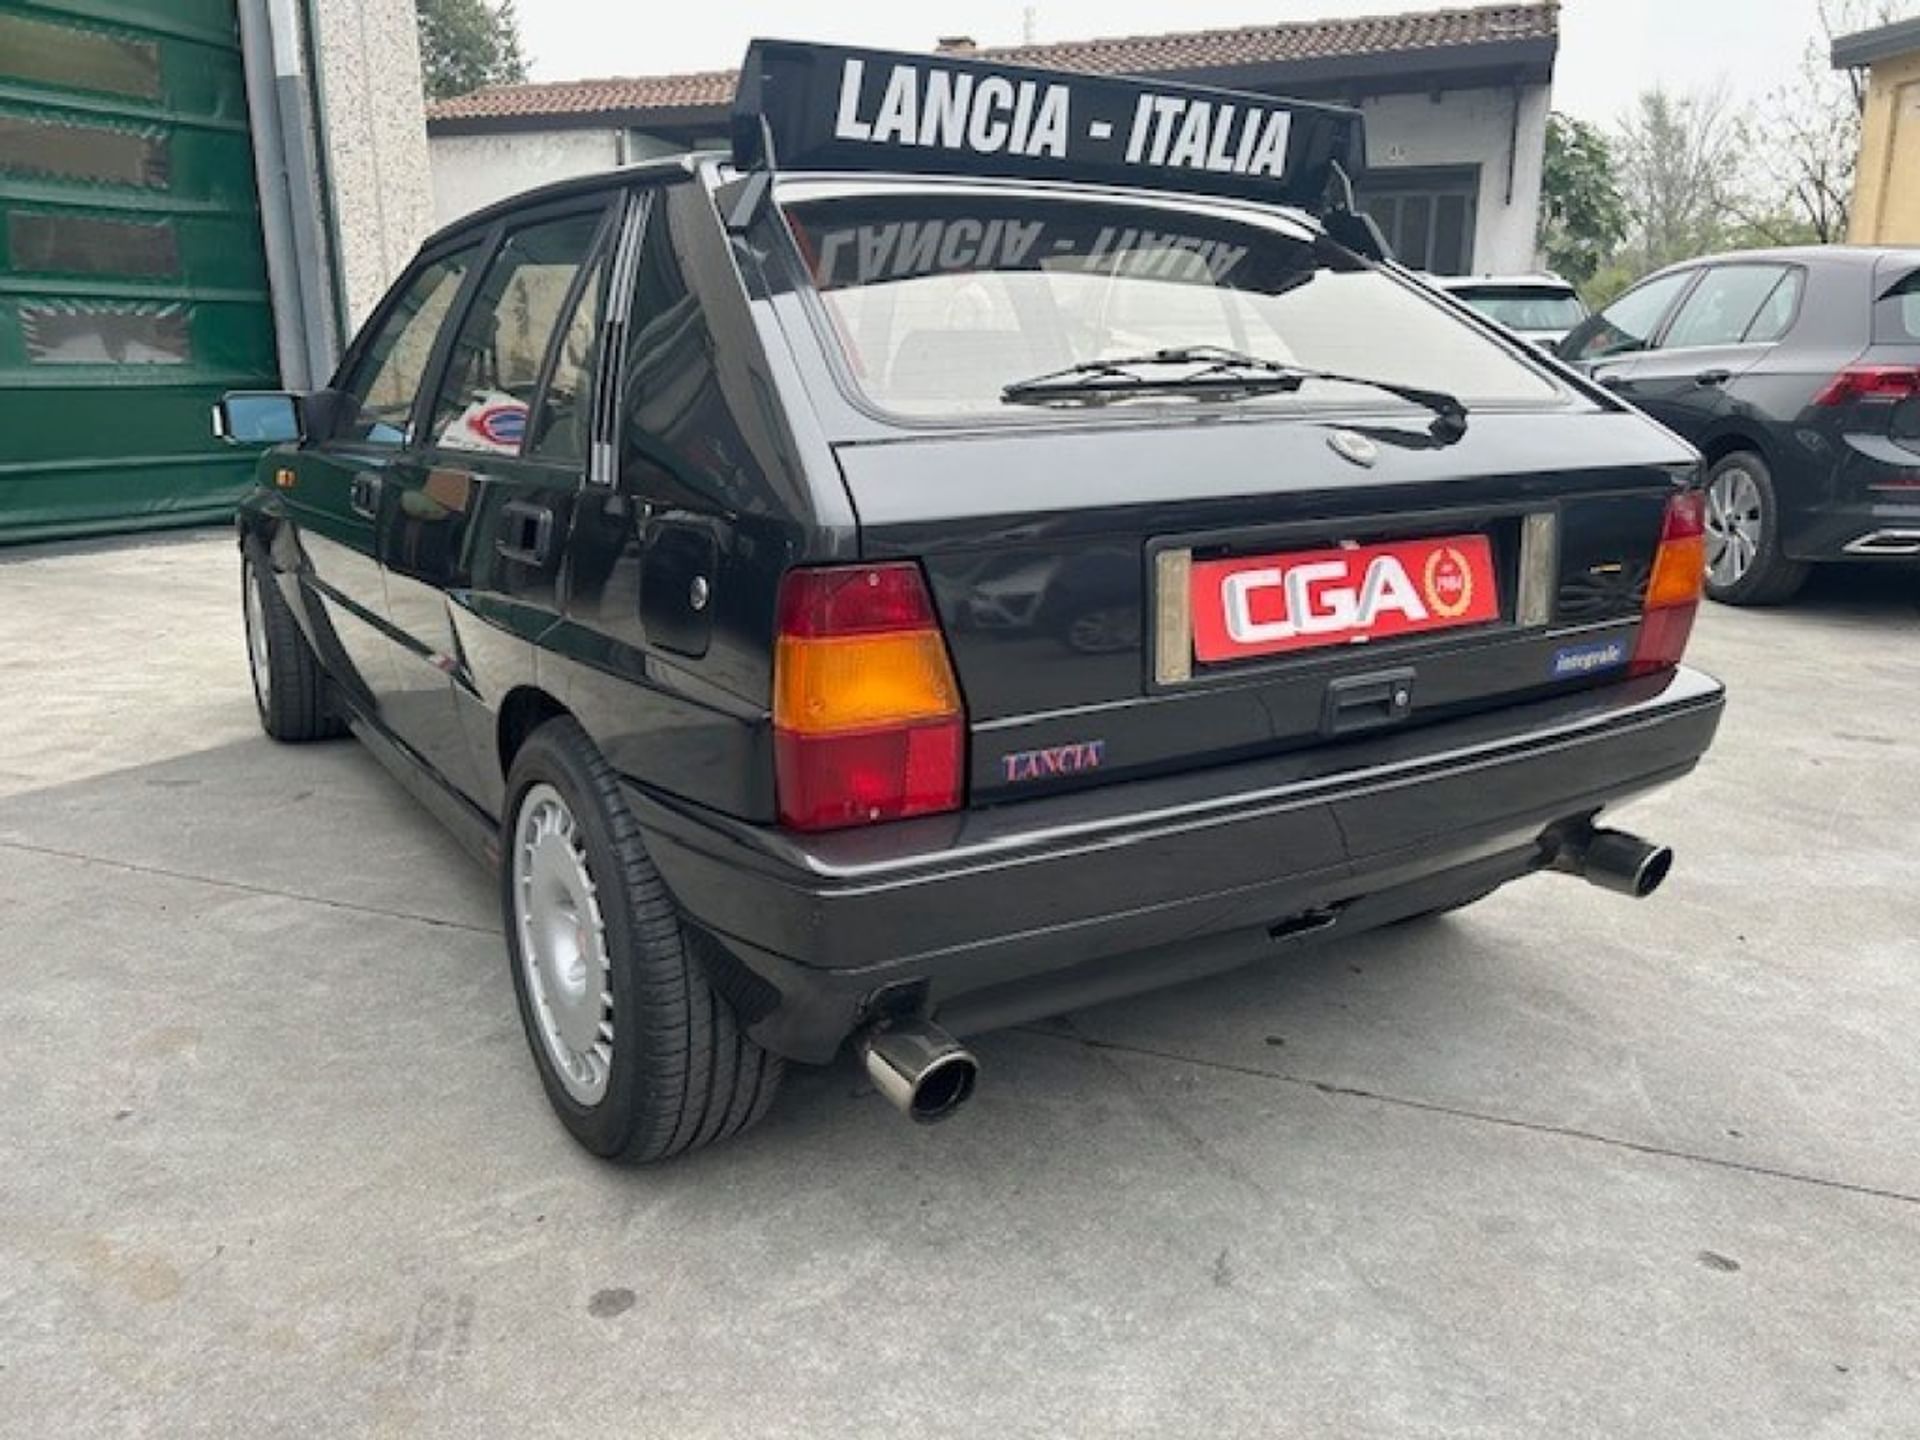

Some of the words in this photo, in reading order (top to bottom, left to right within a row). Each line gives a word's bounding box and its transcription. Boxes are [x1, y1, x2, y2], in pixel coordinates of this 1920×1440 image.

[835, 59, 1070, 158] LANCIA
[1090, 122, 1111, 138] -
[1125, 94, 1292, 179] ITALIA
[1220, 555, 1429, 643] CGA
[1001, 740, 1105, 782] LANCIA
